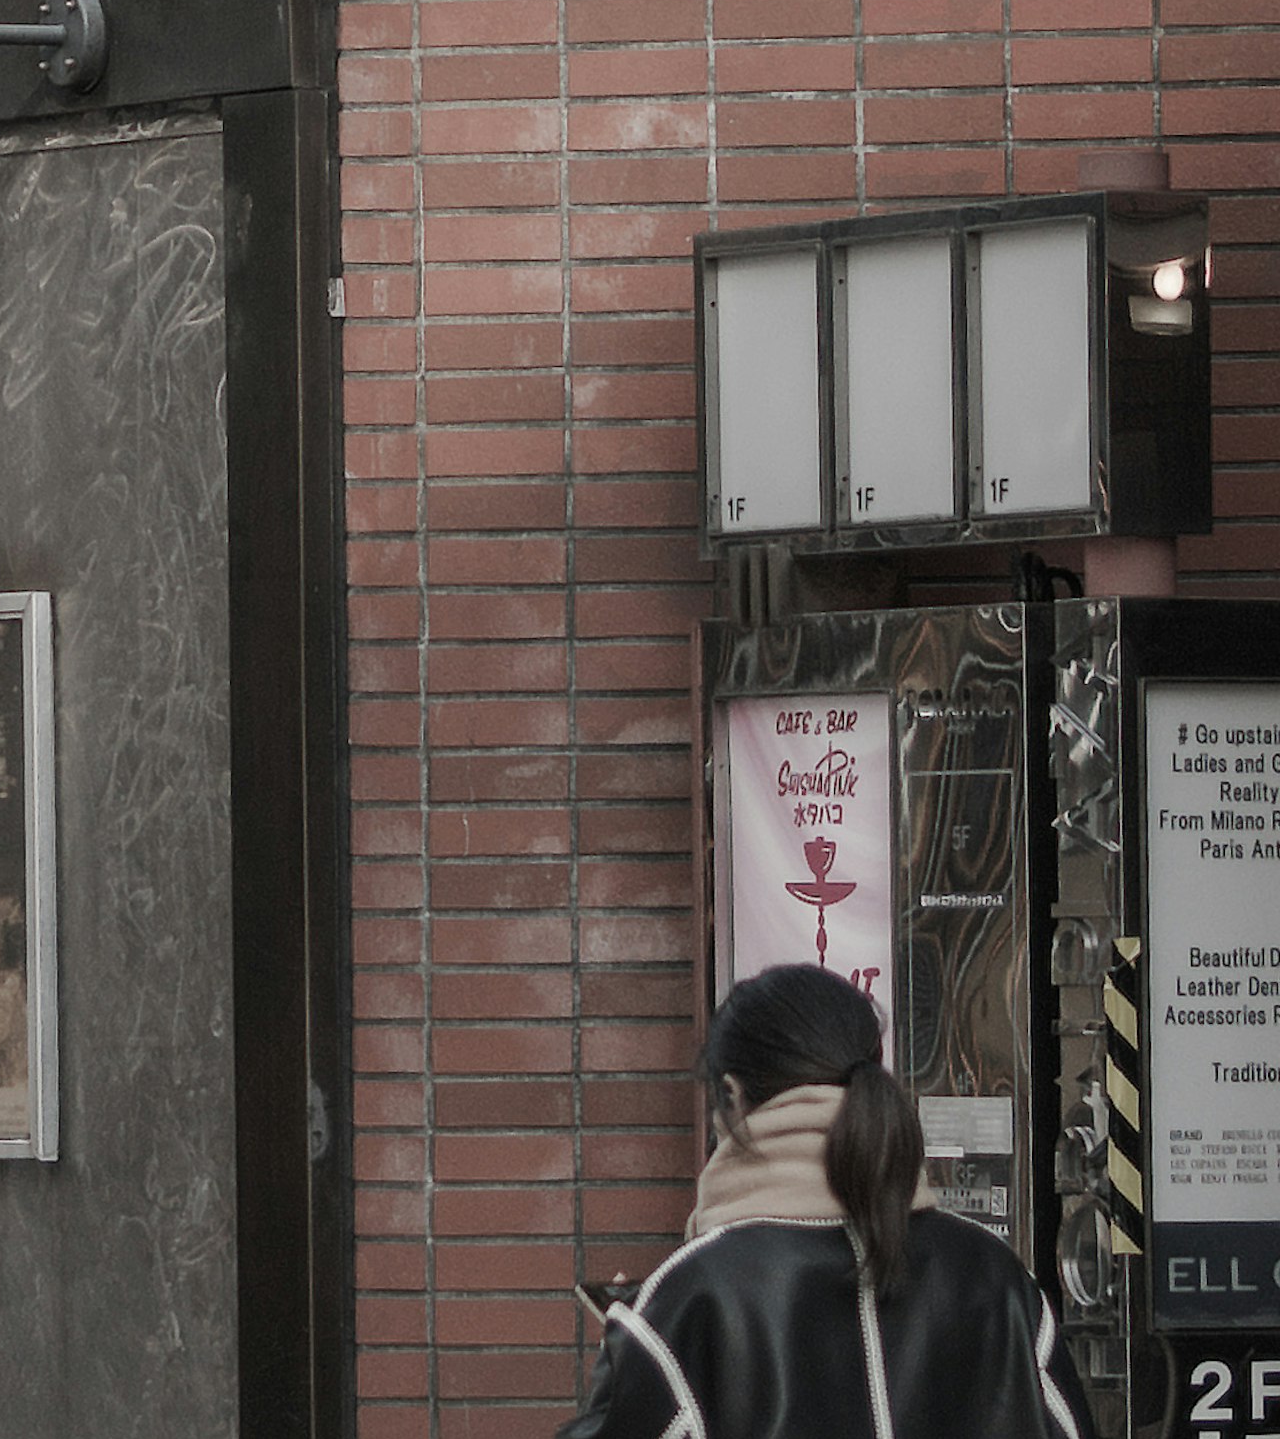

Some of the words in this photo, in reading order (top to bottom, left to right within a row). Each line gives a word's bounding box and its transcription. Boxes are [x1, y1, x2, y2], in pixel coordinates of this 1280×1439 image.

[855, 487, 875, 512] 1F
[991, 477, 1010, 504] 1F
[727, 497, 746, 522] 1F
[776, 710, 812, 735] CAFE
[826, 709, 858, 734] BAR
[1195, 724, 1219, 745] Go
[1172, 752, 1227, 773] Ladies
[1235, 753, 1265, 773] and
[1220, 781, 1279, 805] Reality
[793, 801, 843, 827] 水タバコ
[1159, 810, 1204, 831] From
[1211, 810, 1265, 831] Milano
[1200, 839, 1244, 860] Paris
[1190, 947, 1265, 968] Beautiful
[1176, 976, 1241, 997] Leather
[1165, 1005, 1266, 1025] Accessories
[1168, 1257, 1258, 1292] ELL
